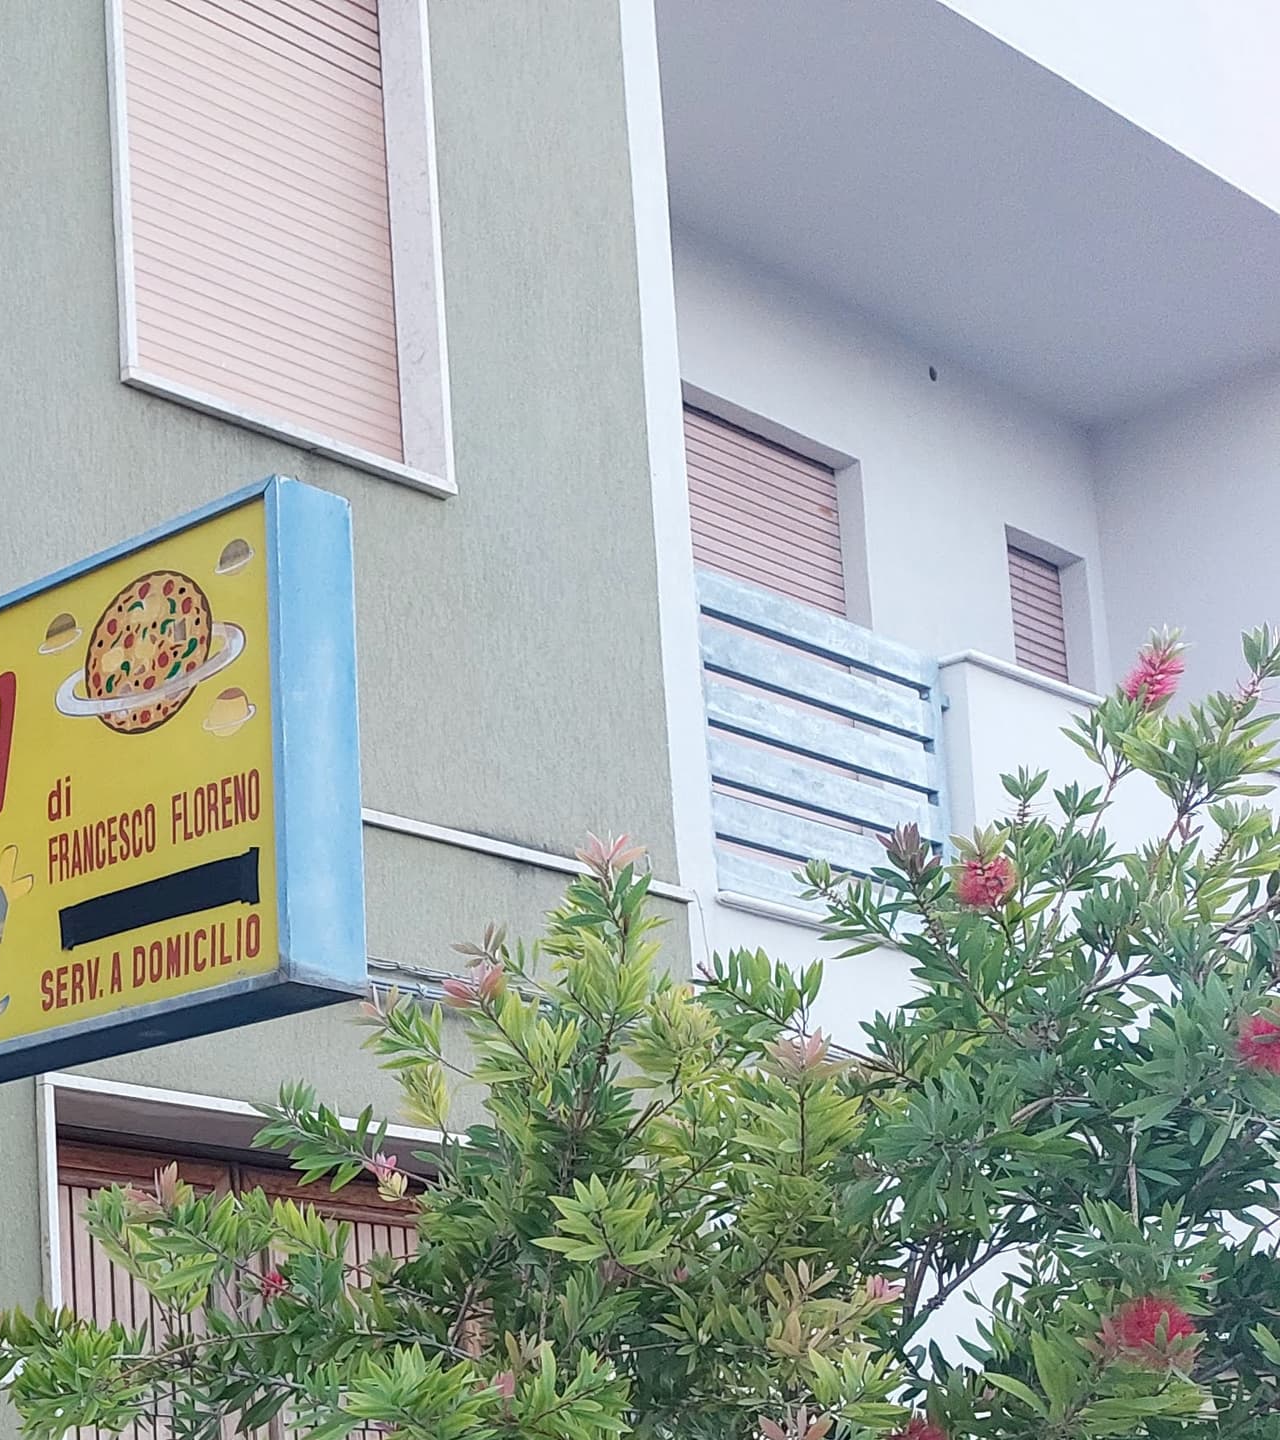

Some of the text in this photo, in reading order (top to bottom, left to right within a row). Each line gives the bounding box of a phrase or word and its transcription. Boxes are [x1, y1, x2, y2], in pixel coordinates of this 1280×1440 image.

[48, 775, 72, 821] di
[48, 768, 261, 885] FRANCESCO FLORENO
[40, 914, 261, 1012] SERV. A DOMICILIO
